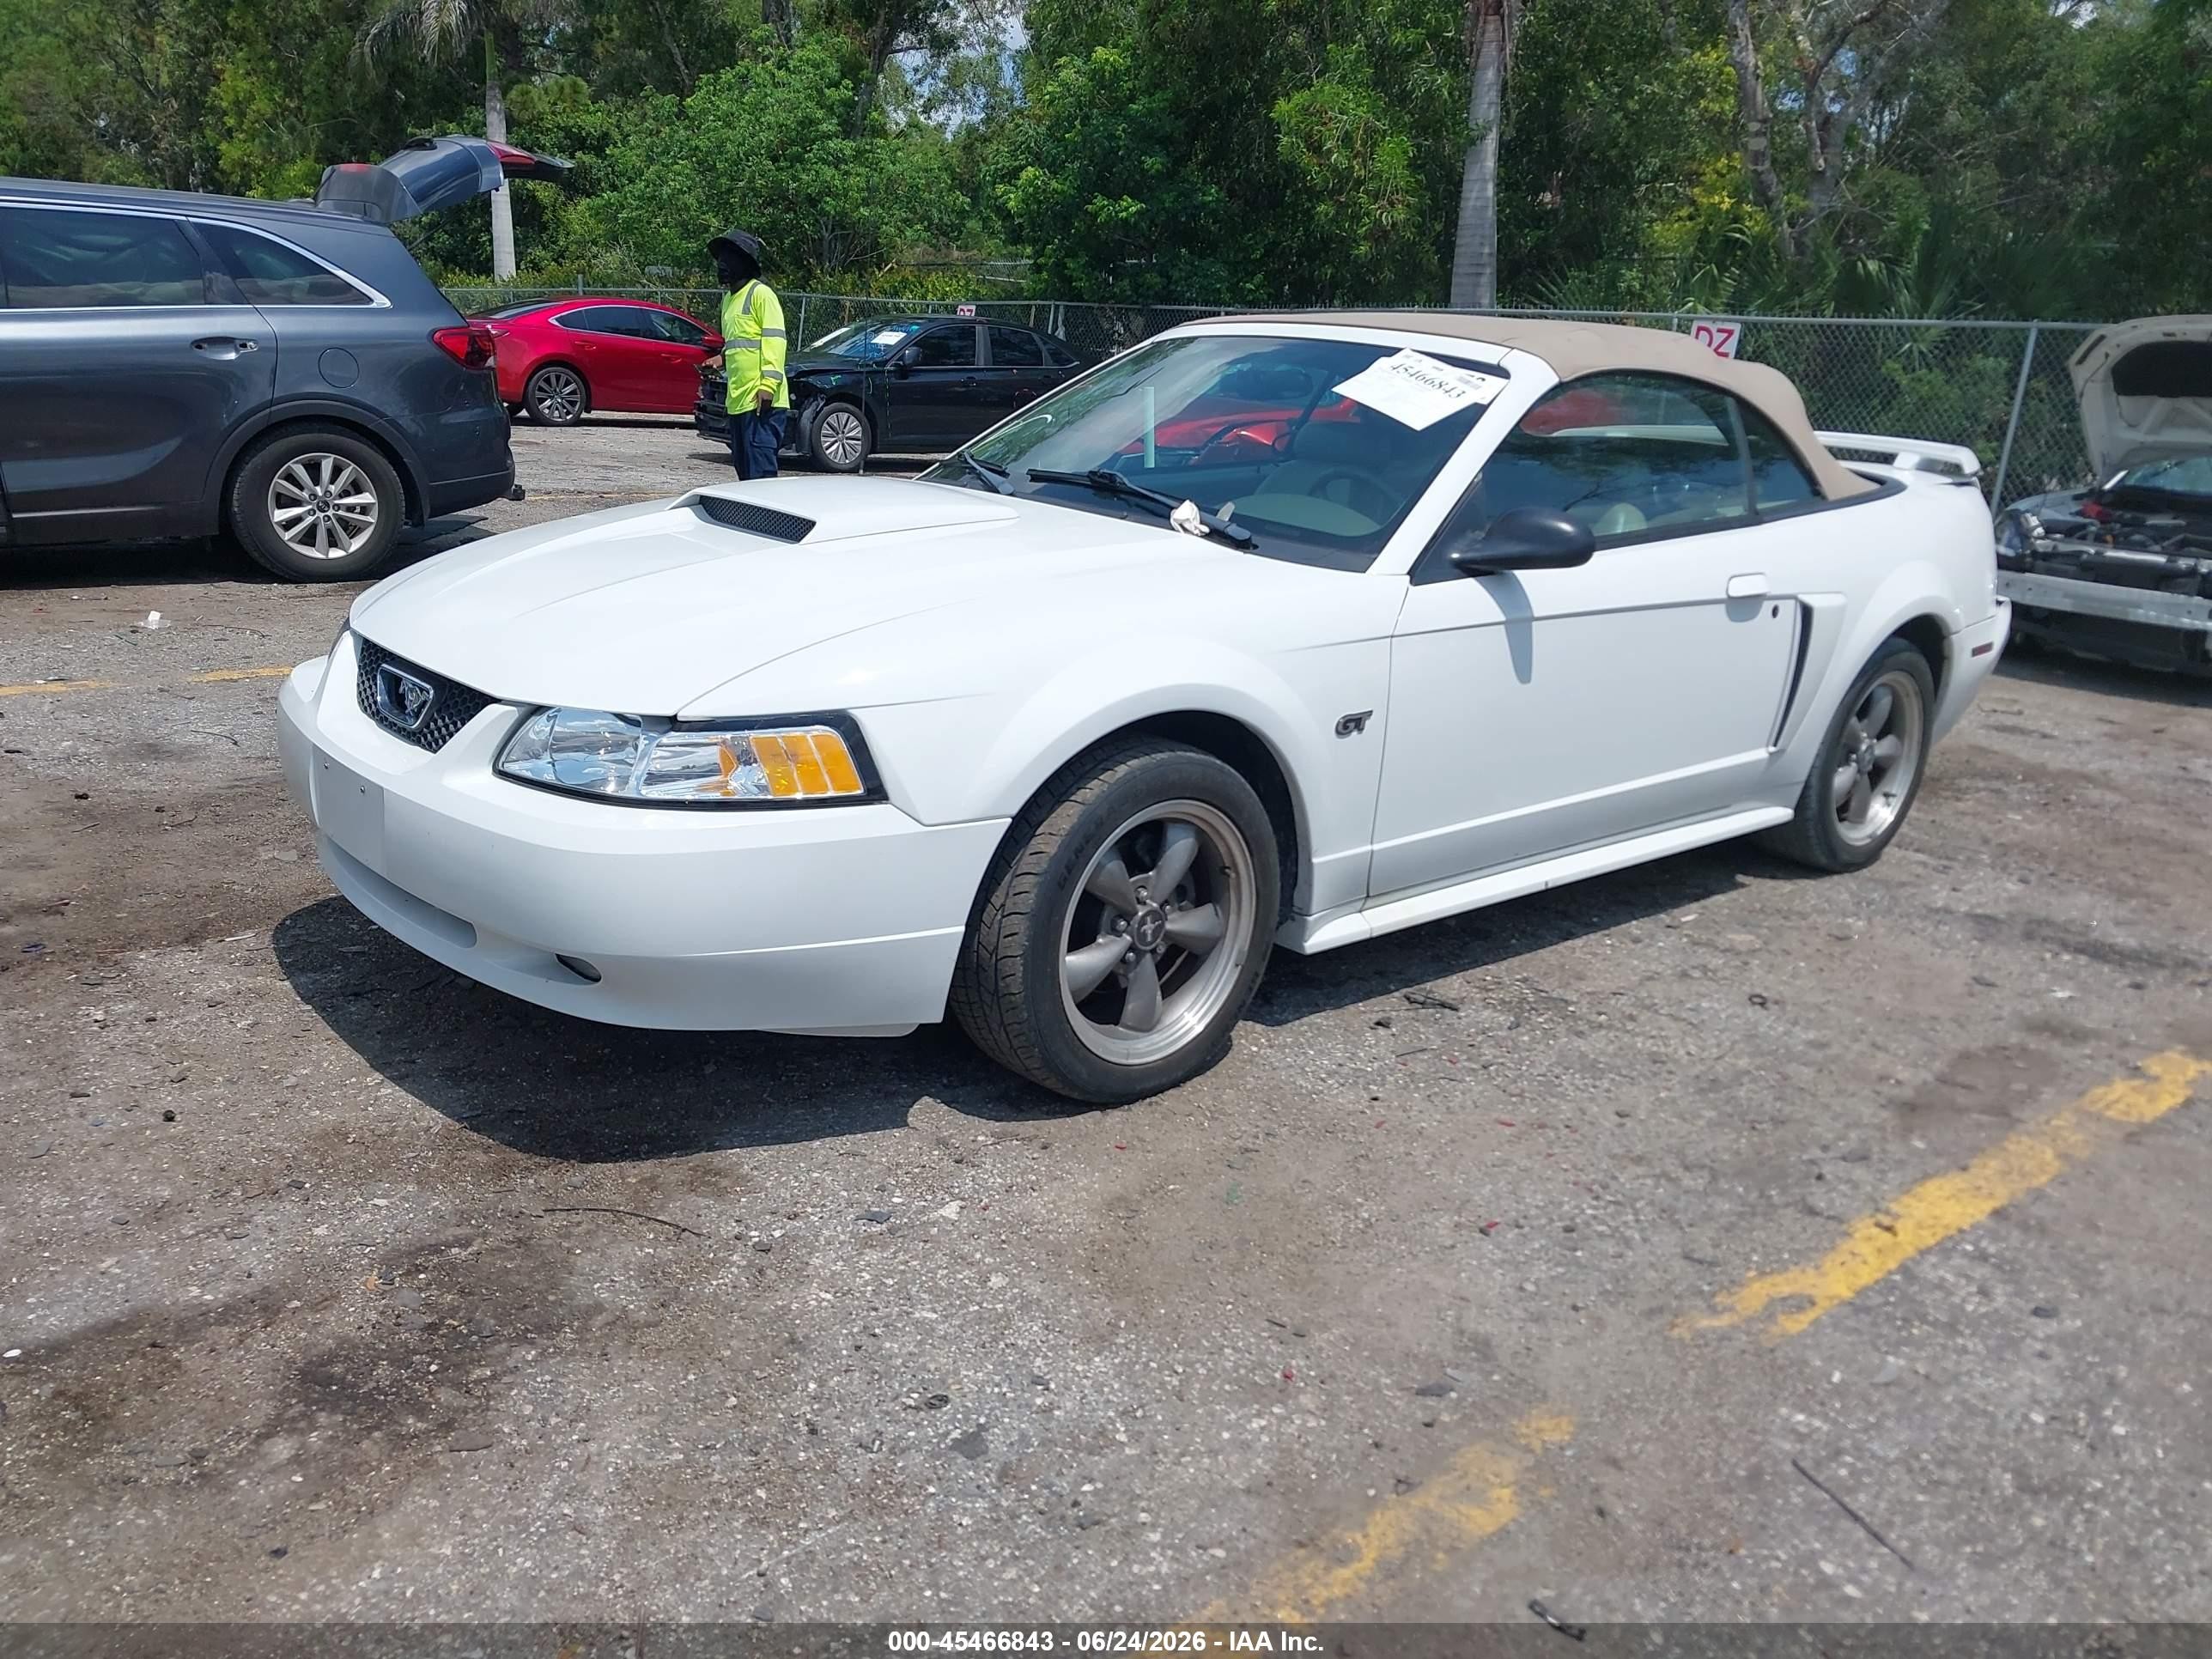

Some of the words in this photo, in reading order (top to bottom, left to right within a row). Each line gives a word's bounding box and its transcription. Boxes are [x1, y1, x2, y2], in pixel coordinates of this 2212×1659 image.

[1694, 325, 1735, 358] DZ
[1389, 362, 1467, 399] 45466843
[1334, 709, 1374, 739] GT
